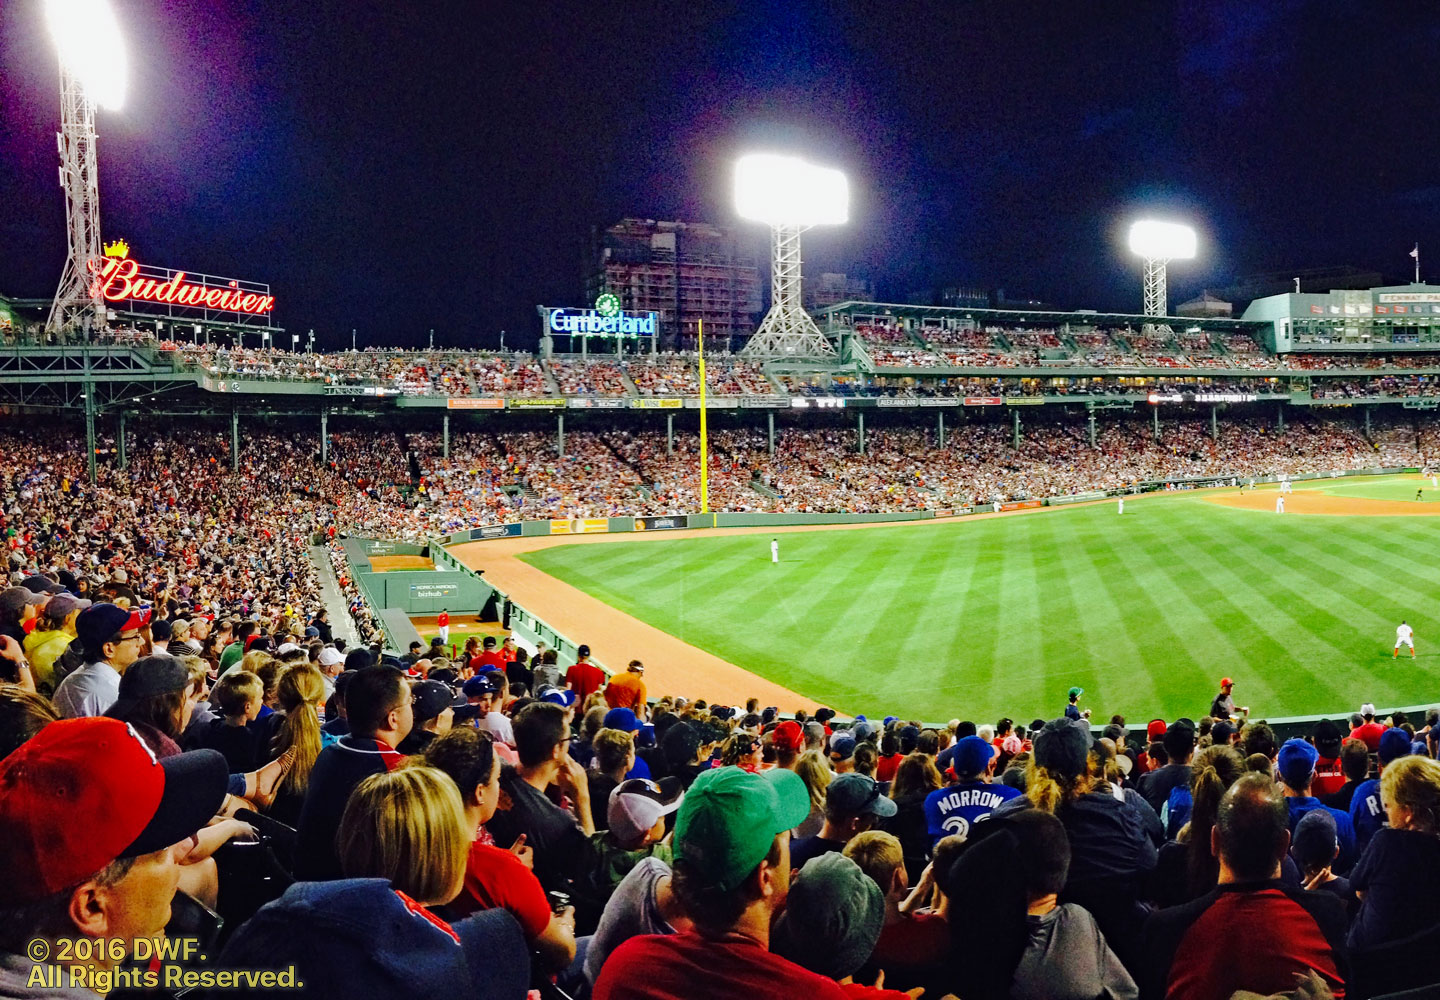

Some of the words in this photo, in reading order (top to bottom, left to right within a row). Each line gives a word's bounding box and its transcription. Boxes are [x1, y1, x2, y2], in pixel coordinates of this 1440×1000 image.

[88, 255, 275, 314] Budweiser
[550, 309, 657, 334] Cumberland
[418, 590, 442, 598] bizhub
[937, 789, 1004, 815] MORROW
